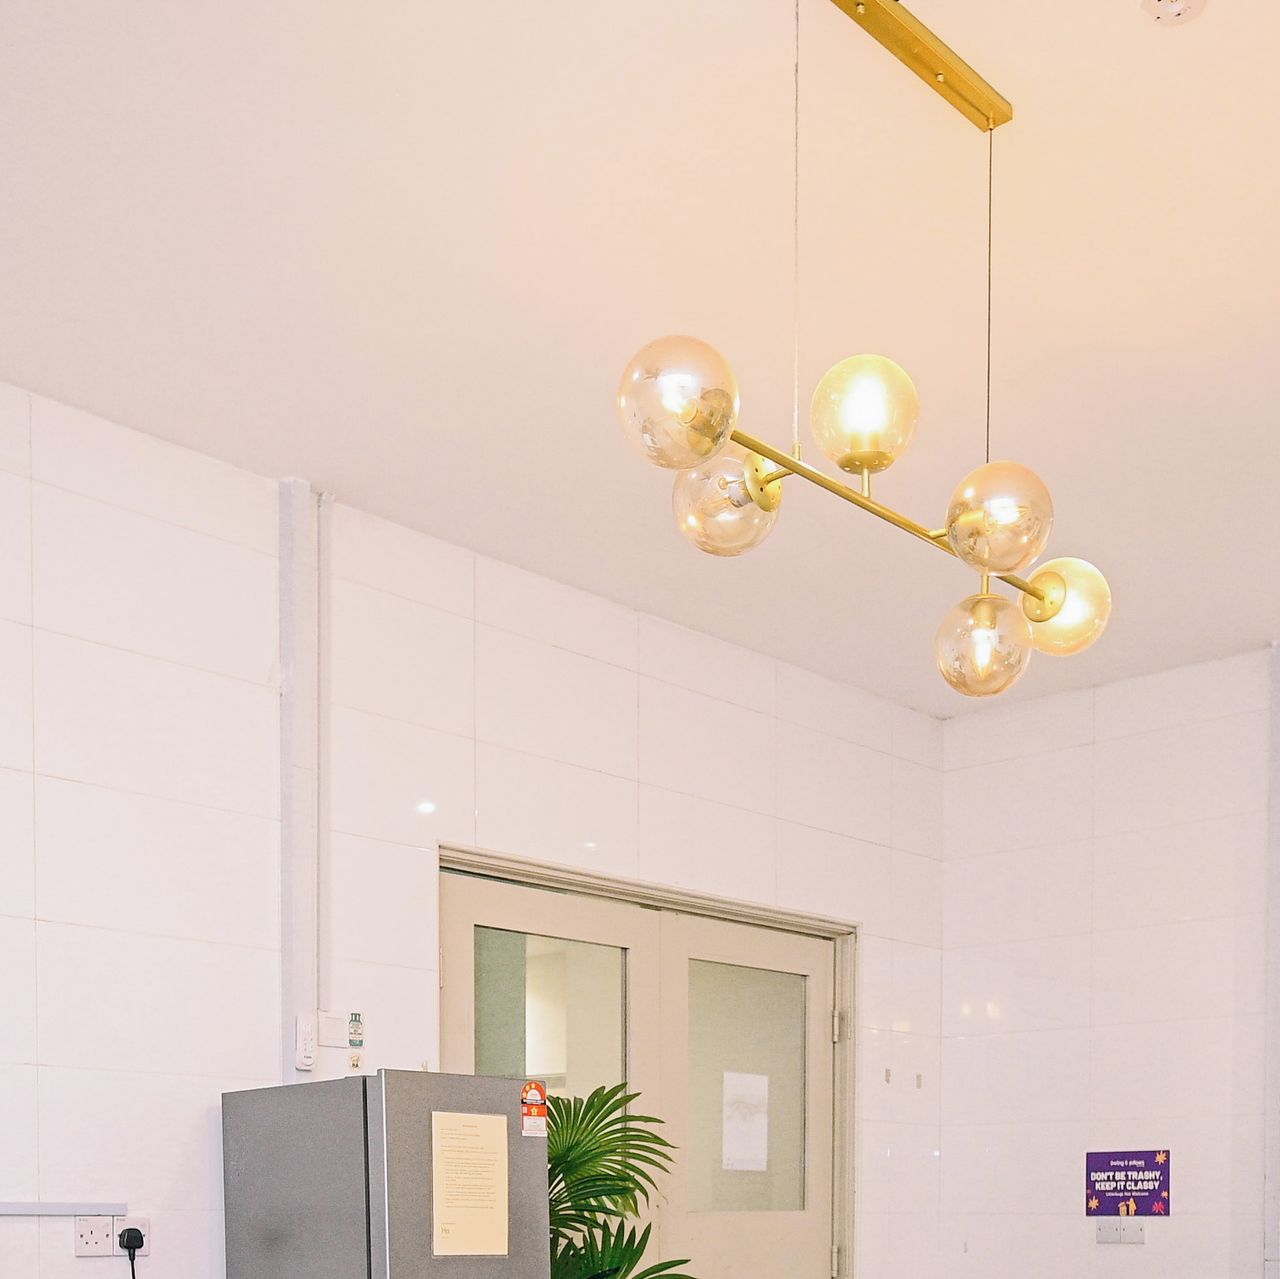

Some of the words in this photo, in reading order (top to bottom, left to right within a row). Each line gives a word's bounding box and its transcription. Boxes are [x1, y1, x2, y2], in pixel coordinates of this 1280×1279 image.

[1091, 1171, 1115, 1181] DON'T
[1115, 1171, 1126, 1180] BE
[1127, 1170, 1163, 1181] TRASHY,
[1095, 1181, 1117, 1190] KEEP
[1117, 1181, 1125, 1190] IT
[1126, 1180, 1160, 1190] CLASSY
